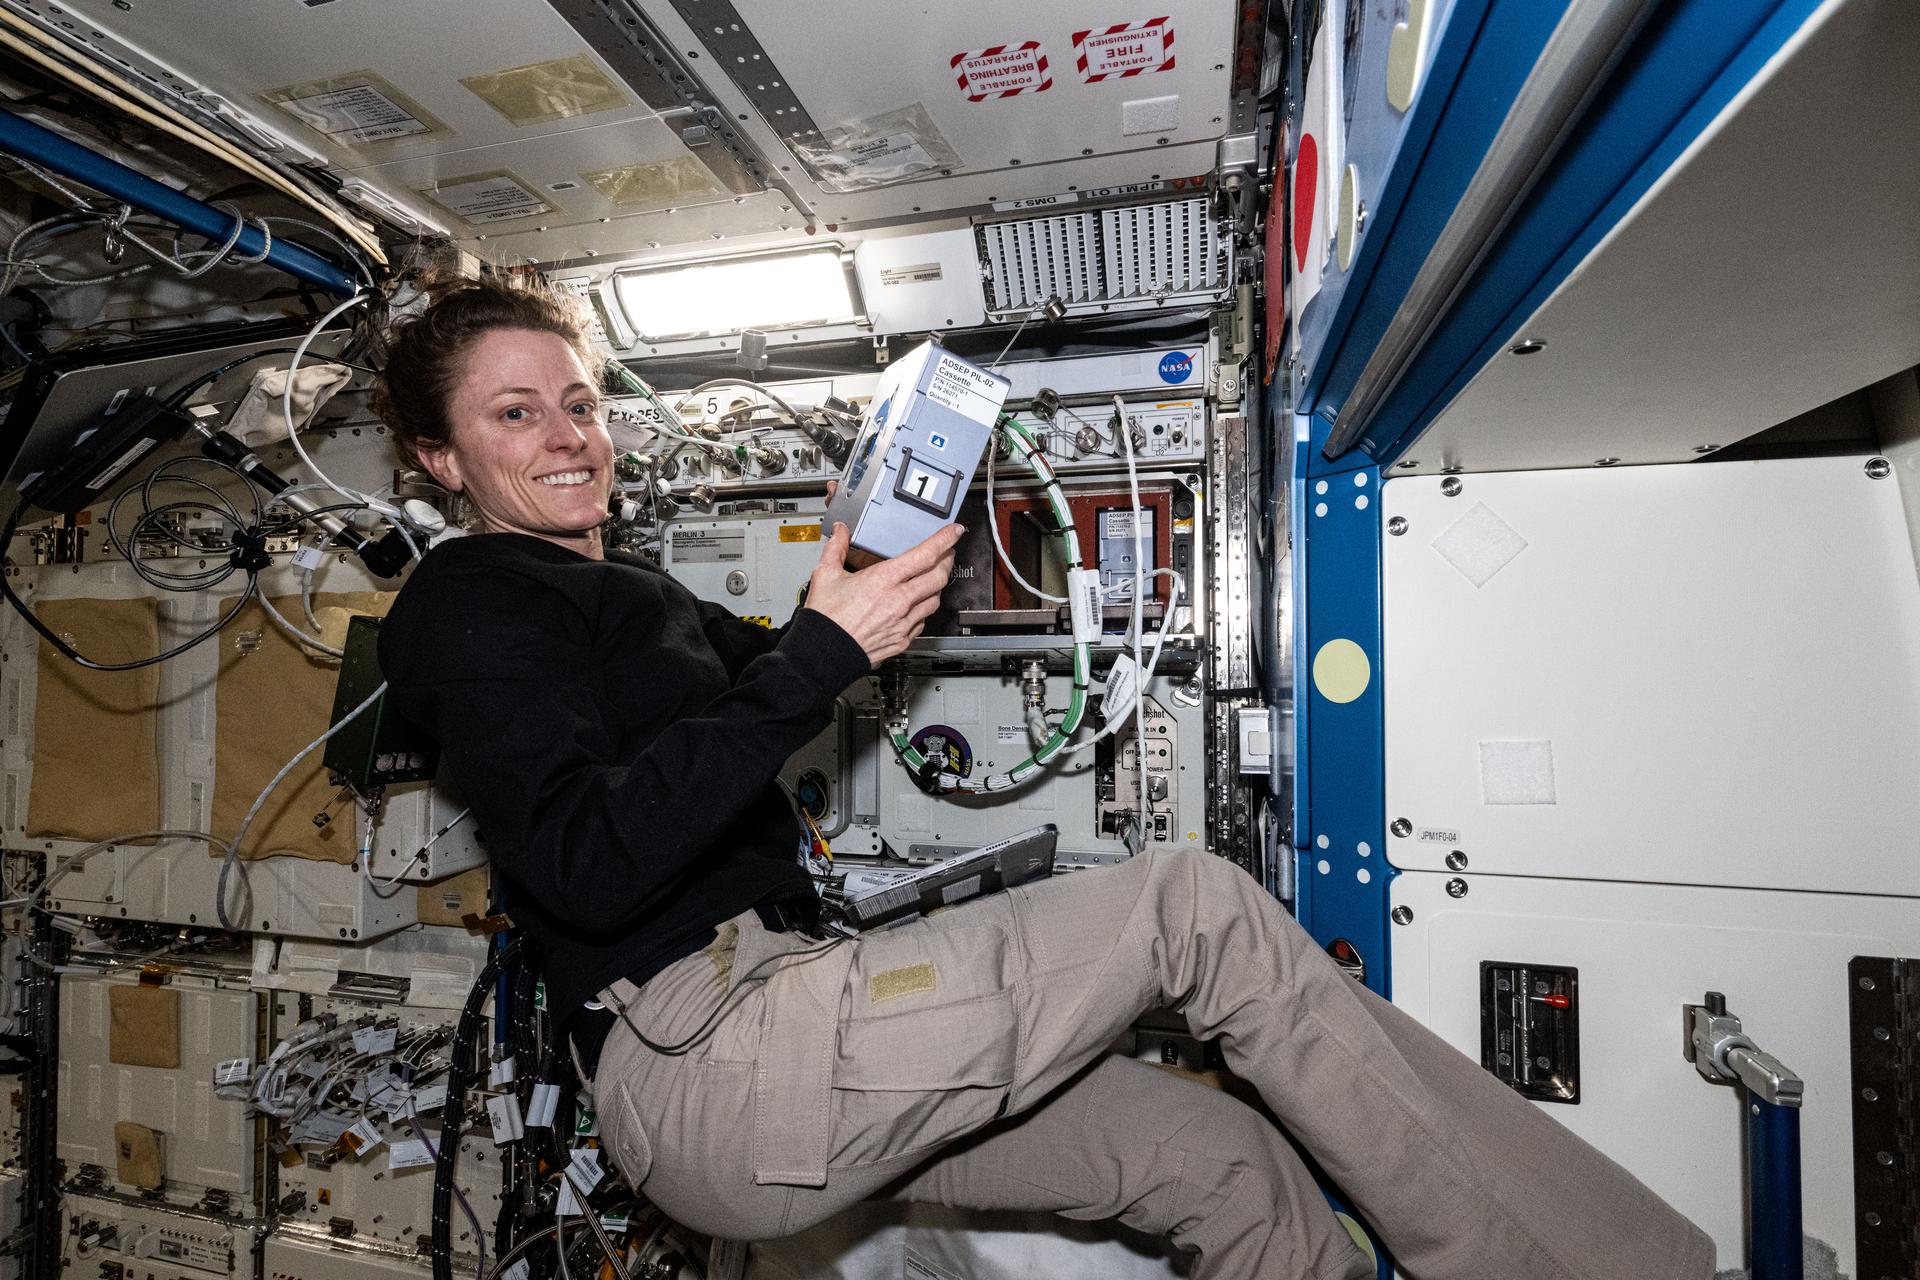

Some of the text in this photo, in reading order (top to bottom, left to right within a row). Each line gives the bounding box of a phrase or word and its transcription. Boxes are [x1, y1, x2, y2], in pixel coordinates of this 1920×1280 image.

[1088, 29, 1158, 48] EXTINGUISHER
[1105, 43, 1144, 59] FIRE
[966, 51, 1029, 69] APPARATUS
[1099, 55, 1153, 70] PORTABLE
[969, 62, 1035, 81] BREATHING
[979, 76, 1033, 91] PORTABLE
[1119, 182, 1160, 194] JPM1
[1014, 196, 1057, 208] DMS 2
[941, 358, 995, 388] ADSEP PIL-02
[1161, 363, 1190, 373] NASA
[938, 366, 972, 387] Cassette
[707, 396, 718, 415] 5
[928, 391, 952, 406] Quantity
[917, 476, 930, 498] 1
[699, 530, 706, 538] 3
